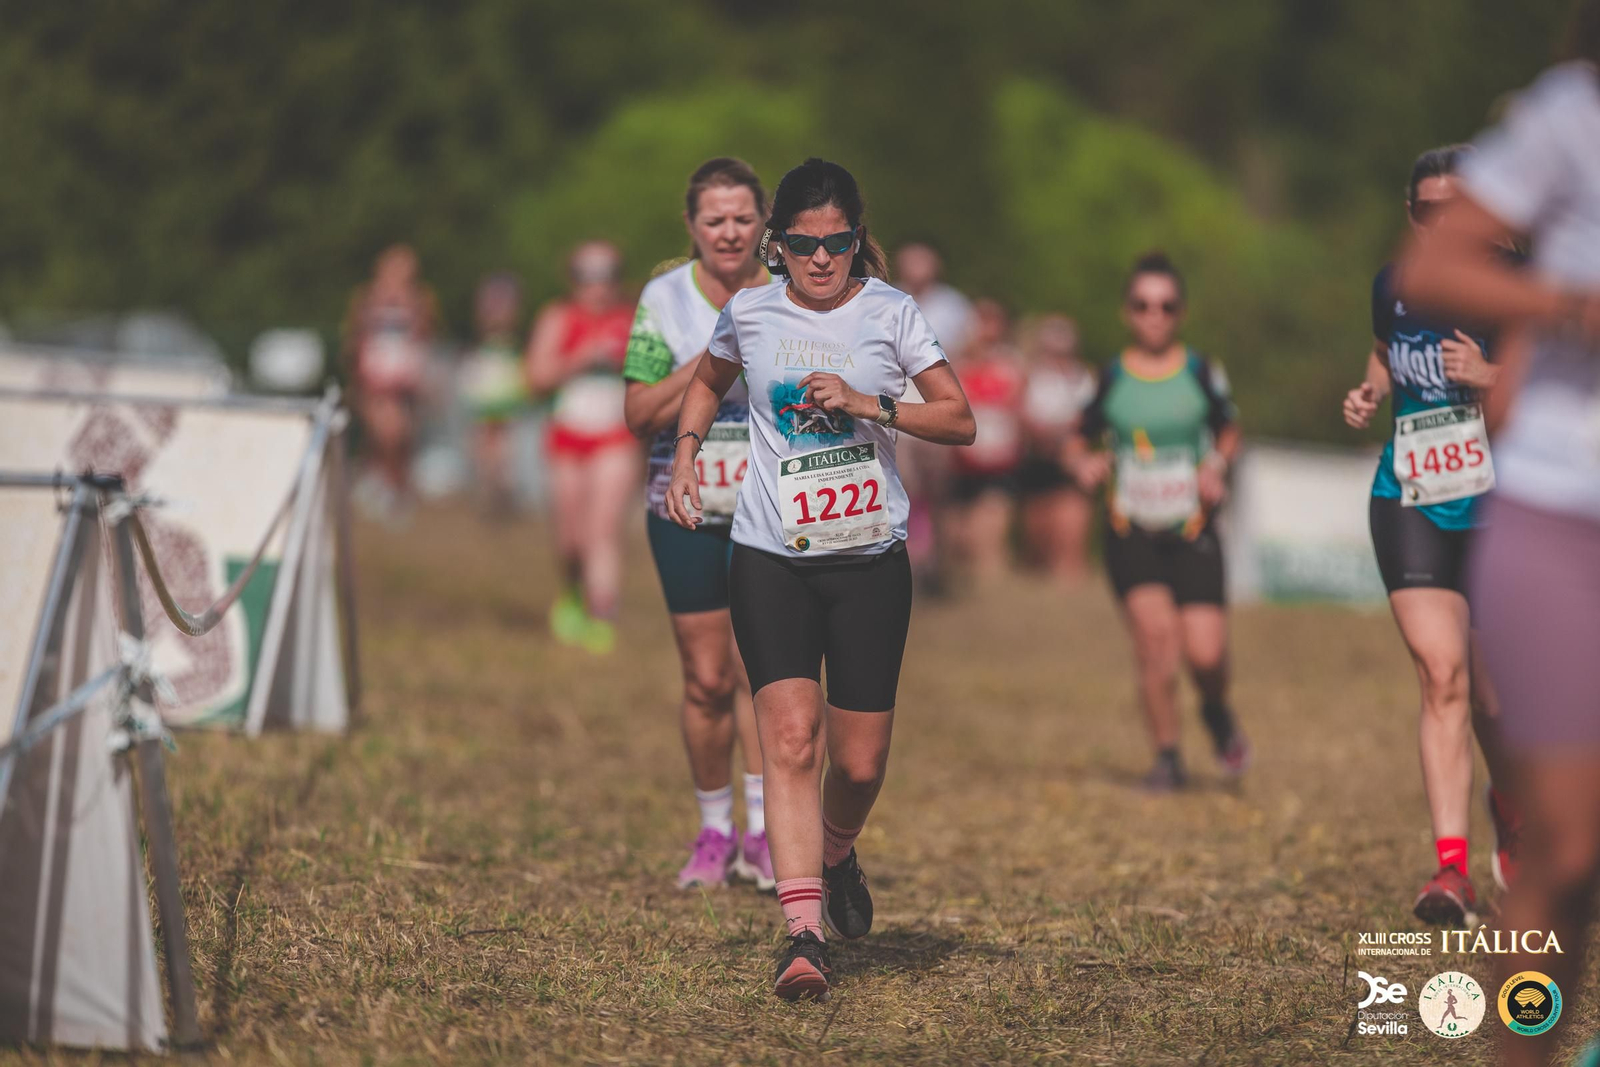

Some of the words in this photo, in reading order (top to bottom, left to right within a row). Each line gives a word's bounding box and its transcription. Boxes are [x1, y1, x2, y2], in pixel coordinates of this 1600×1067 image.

[814, 340, 846, 349] CROSS
[695, 458, 748, 487] 114
[808, 450, 857, 467] ITÁLICA
[1405, 438, 1484, 480] 1485
[792, 478, 883, 525] 1222
